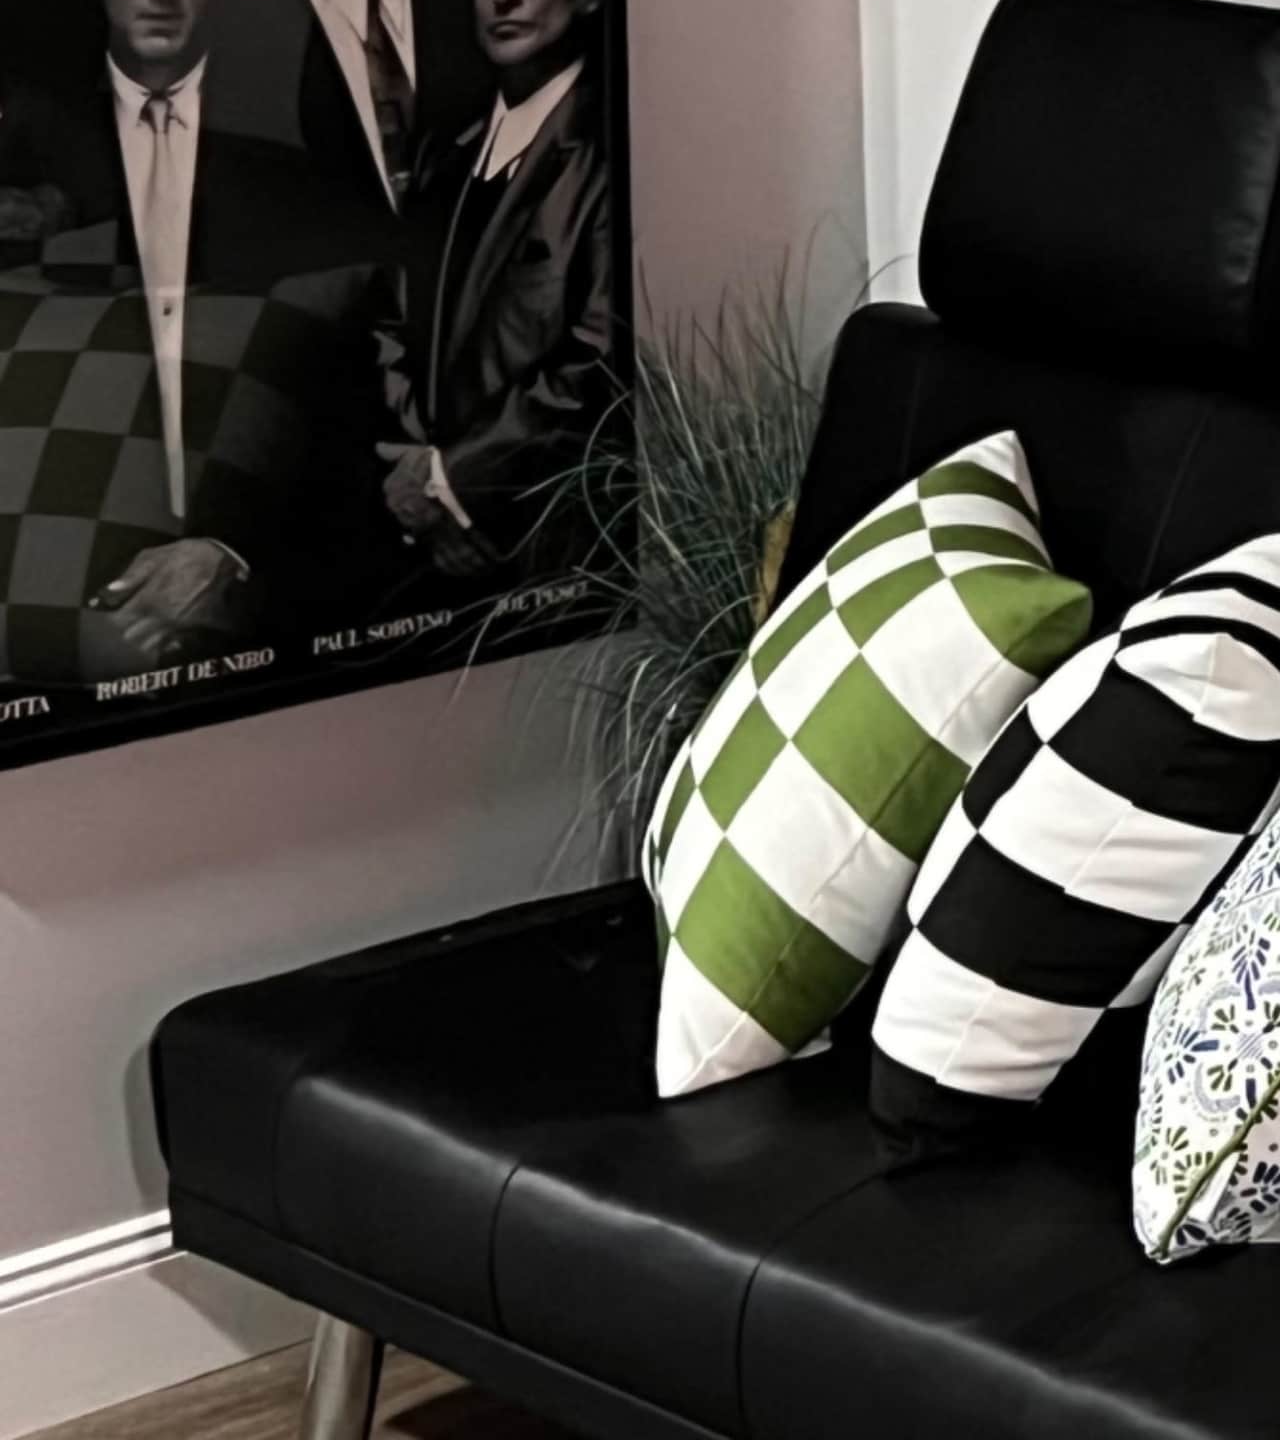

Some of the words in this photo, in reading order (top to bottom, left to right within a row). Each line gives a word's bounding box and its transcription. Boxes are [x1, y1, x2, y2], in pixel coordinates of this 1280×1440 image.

[96, 666, 183, 702] ROBERT
[187, 661, 218, 683] DE
[312, 628, 362, 656] PAUL
[366, 609, 454, 644] SORVINO
